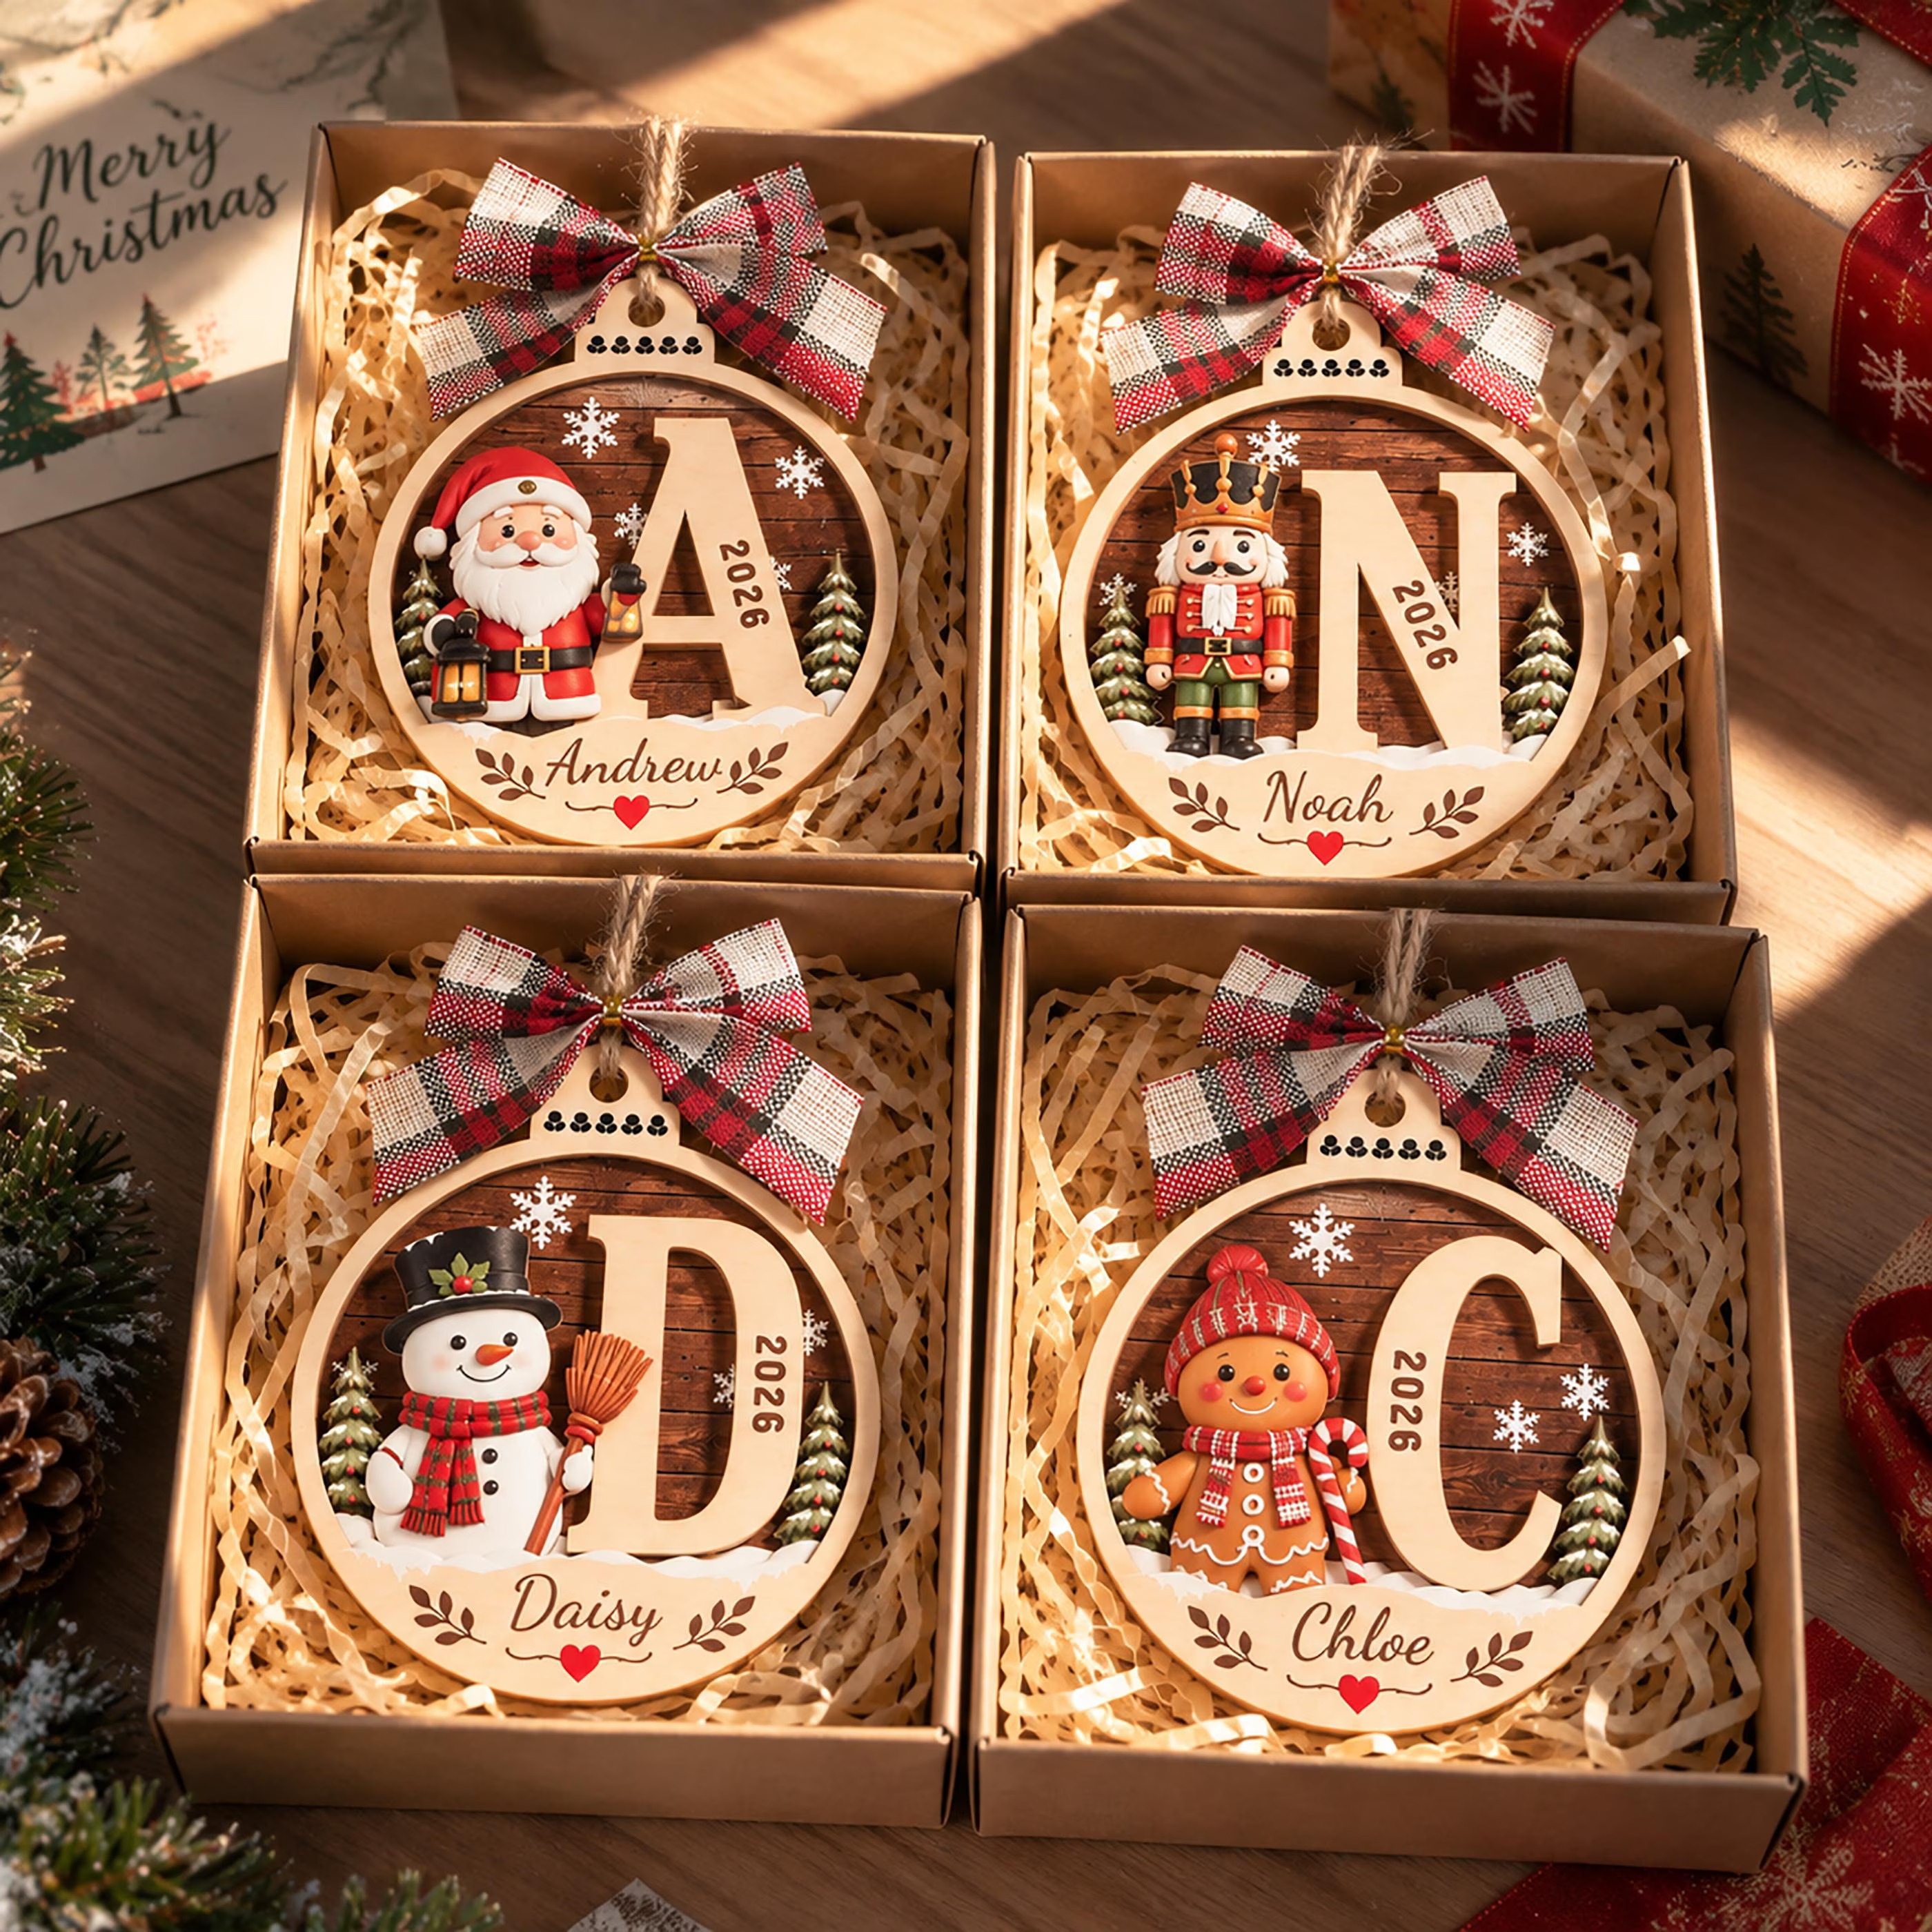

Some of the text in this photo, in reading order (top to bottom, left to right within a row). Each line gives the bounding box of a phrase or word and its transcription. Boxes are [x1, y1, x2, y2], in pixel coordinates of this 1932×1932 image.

[32, 121, 231, 190] Merry
[0, 172, 288, 309] Christmas
[577, 417, 827, 720] A
[719, 540, 770, 629] 2026
[1297, 470, 1517, 752] N
[1392, 580, 1459, 670] 2026
[545, 738, 722, 787] Andrew
[1263, 770, 1394, 823] Noah
[566, 1214, 805, 1554] D
[751, 1335, 788, 1434] 2026
[1366, 1235, 1563, 1592] C
[1388, 1350, 1427, 1452] 2026
[509, 1573, 664, 1647] Daisy
[1292, 1601, 1435, 1666] Chloe
